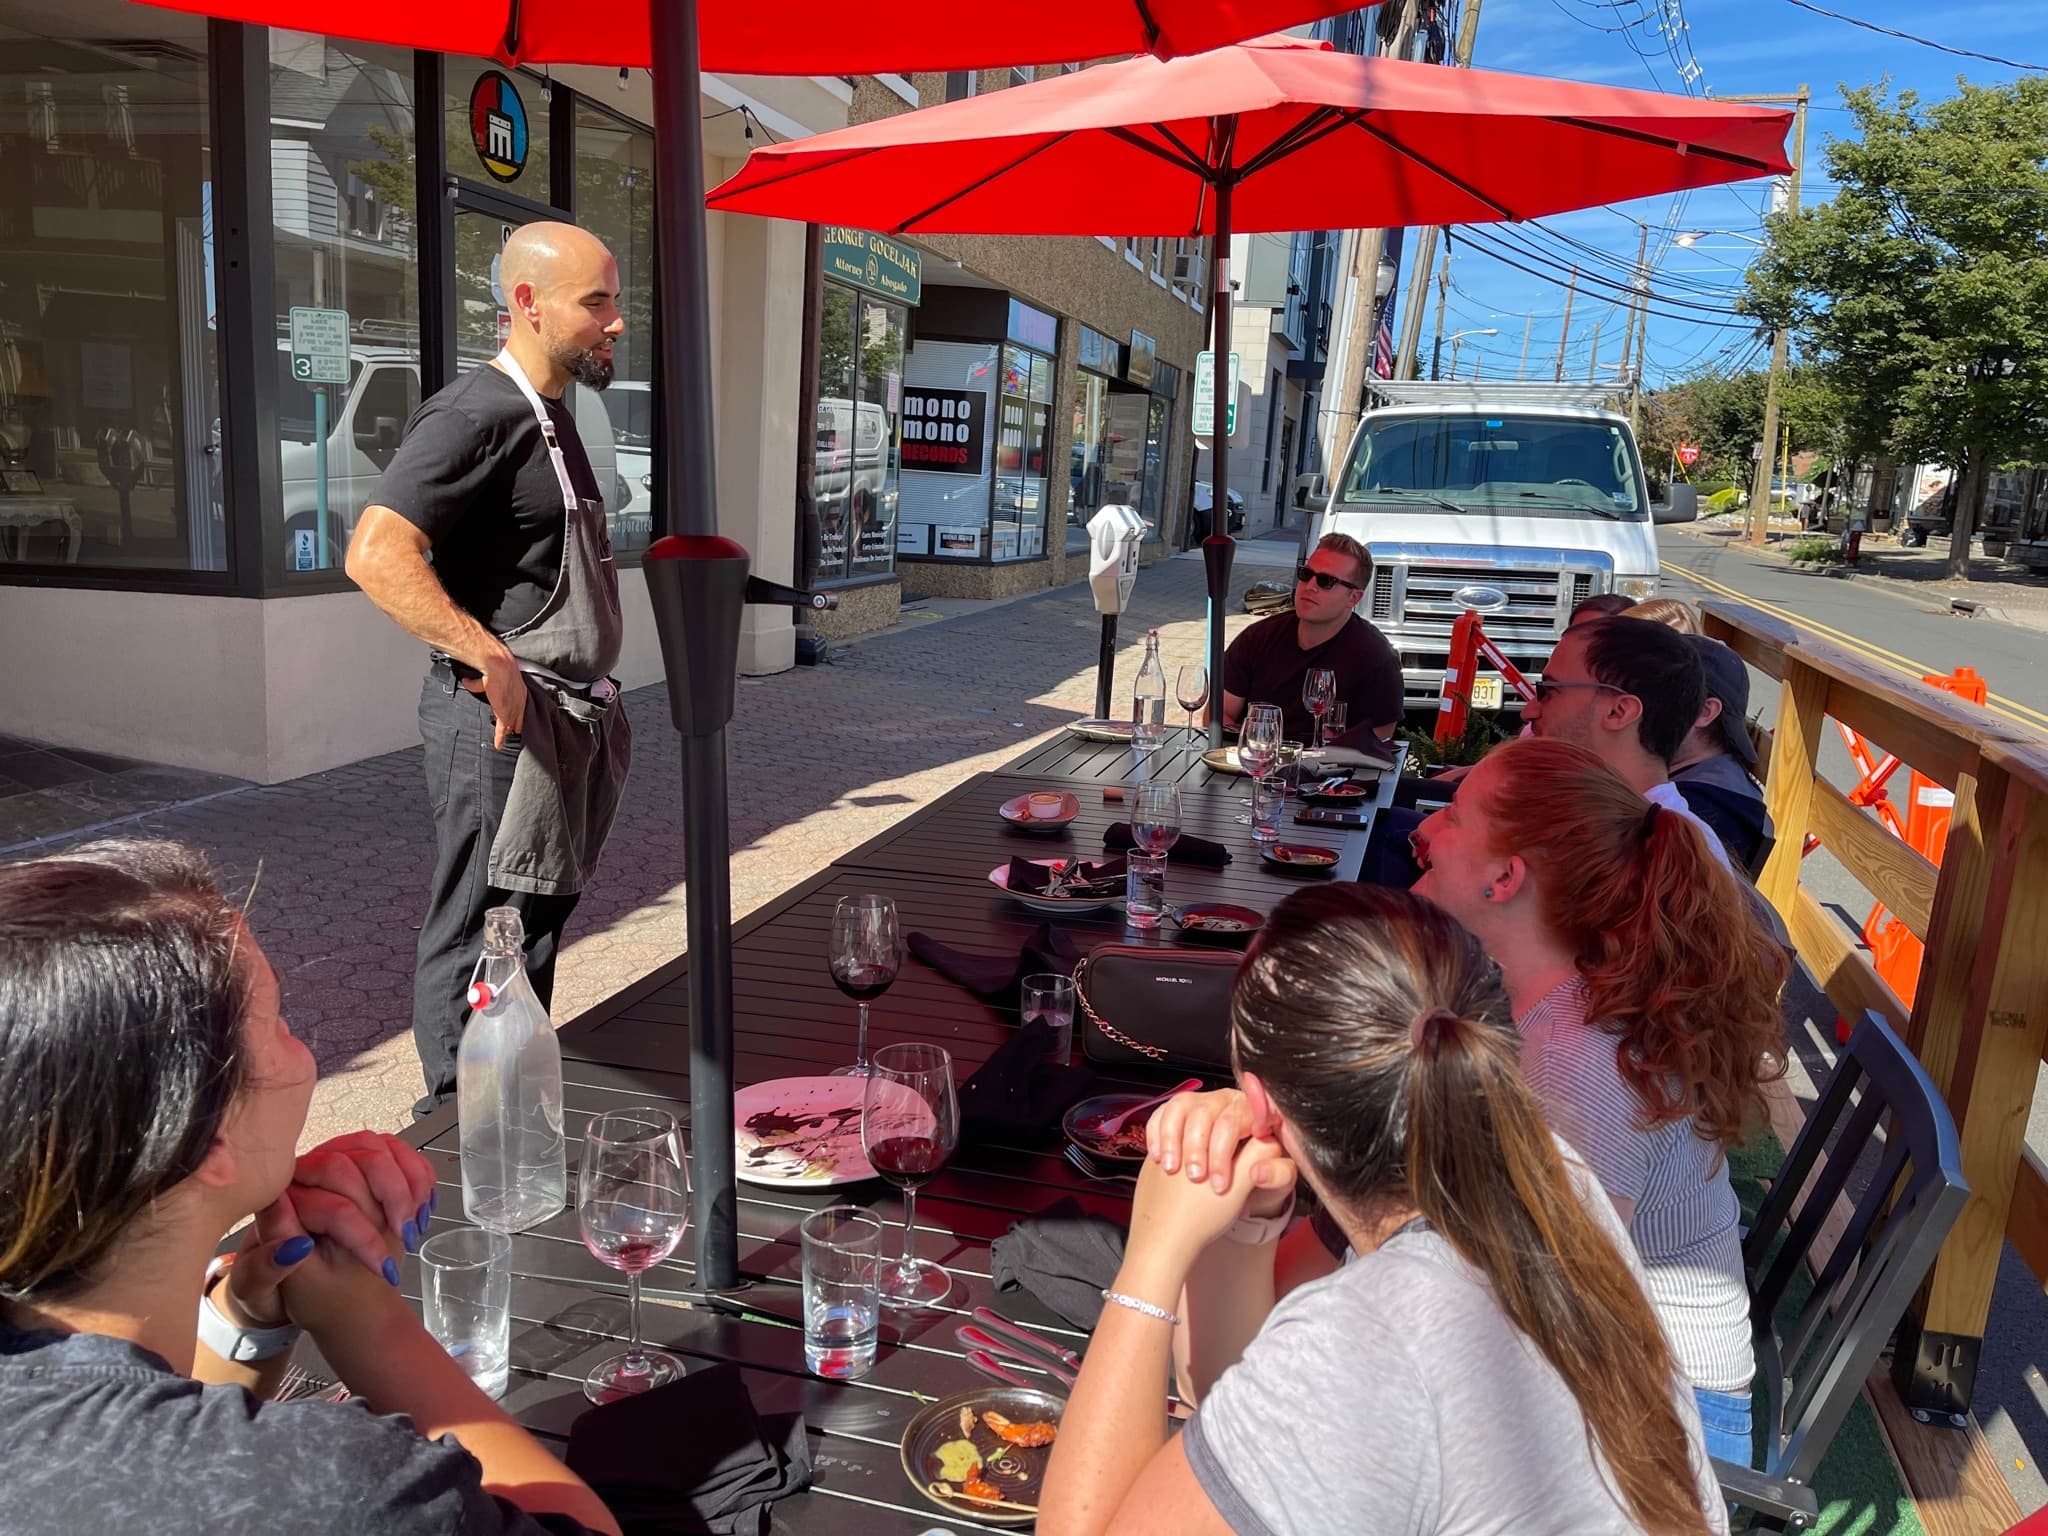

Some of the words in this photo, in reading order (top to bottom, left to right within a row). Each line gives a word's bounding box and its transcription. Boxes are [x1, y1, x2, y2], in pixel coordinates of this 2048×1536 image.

[835, 257, 863, 279] Attorney
[880, 275, 908, 293] Abogado
[904, 396, 971, 420] mono
[903, 420, 970, 443] mono
[902, 443, 968, 464] RECORDS
